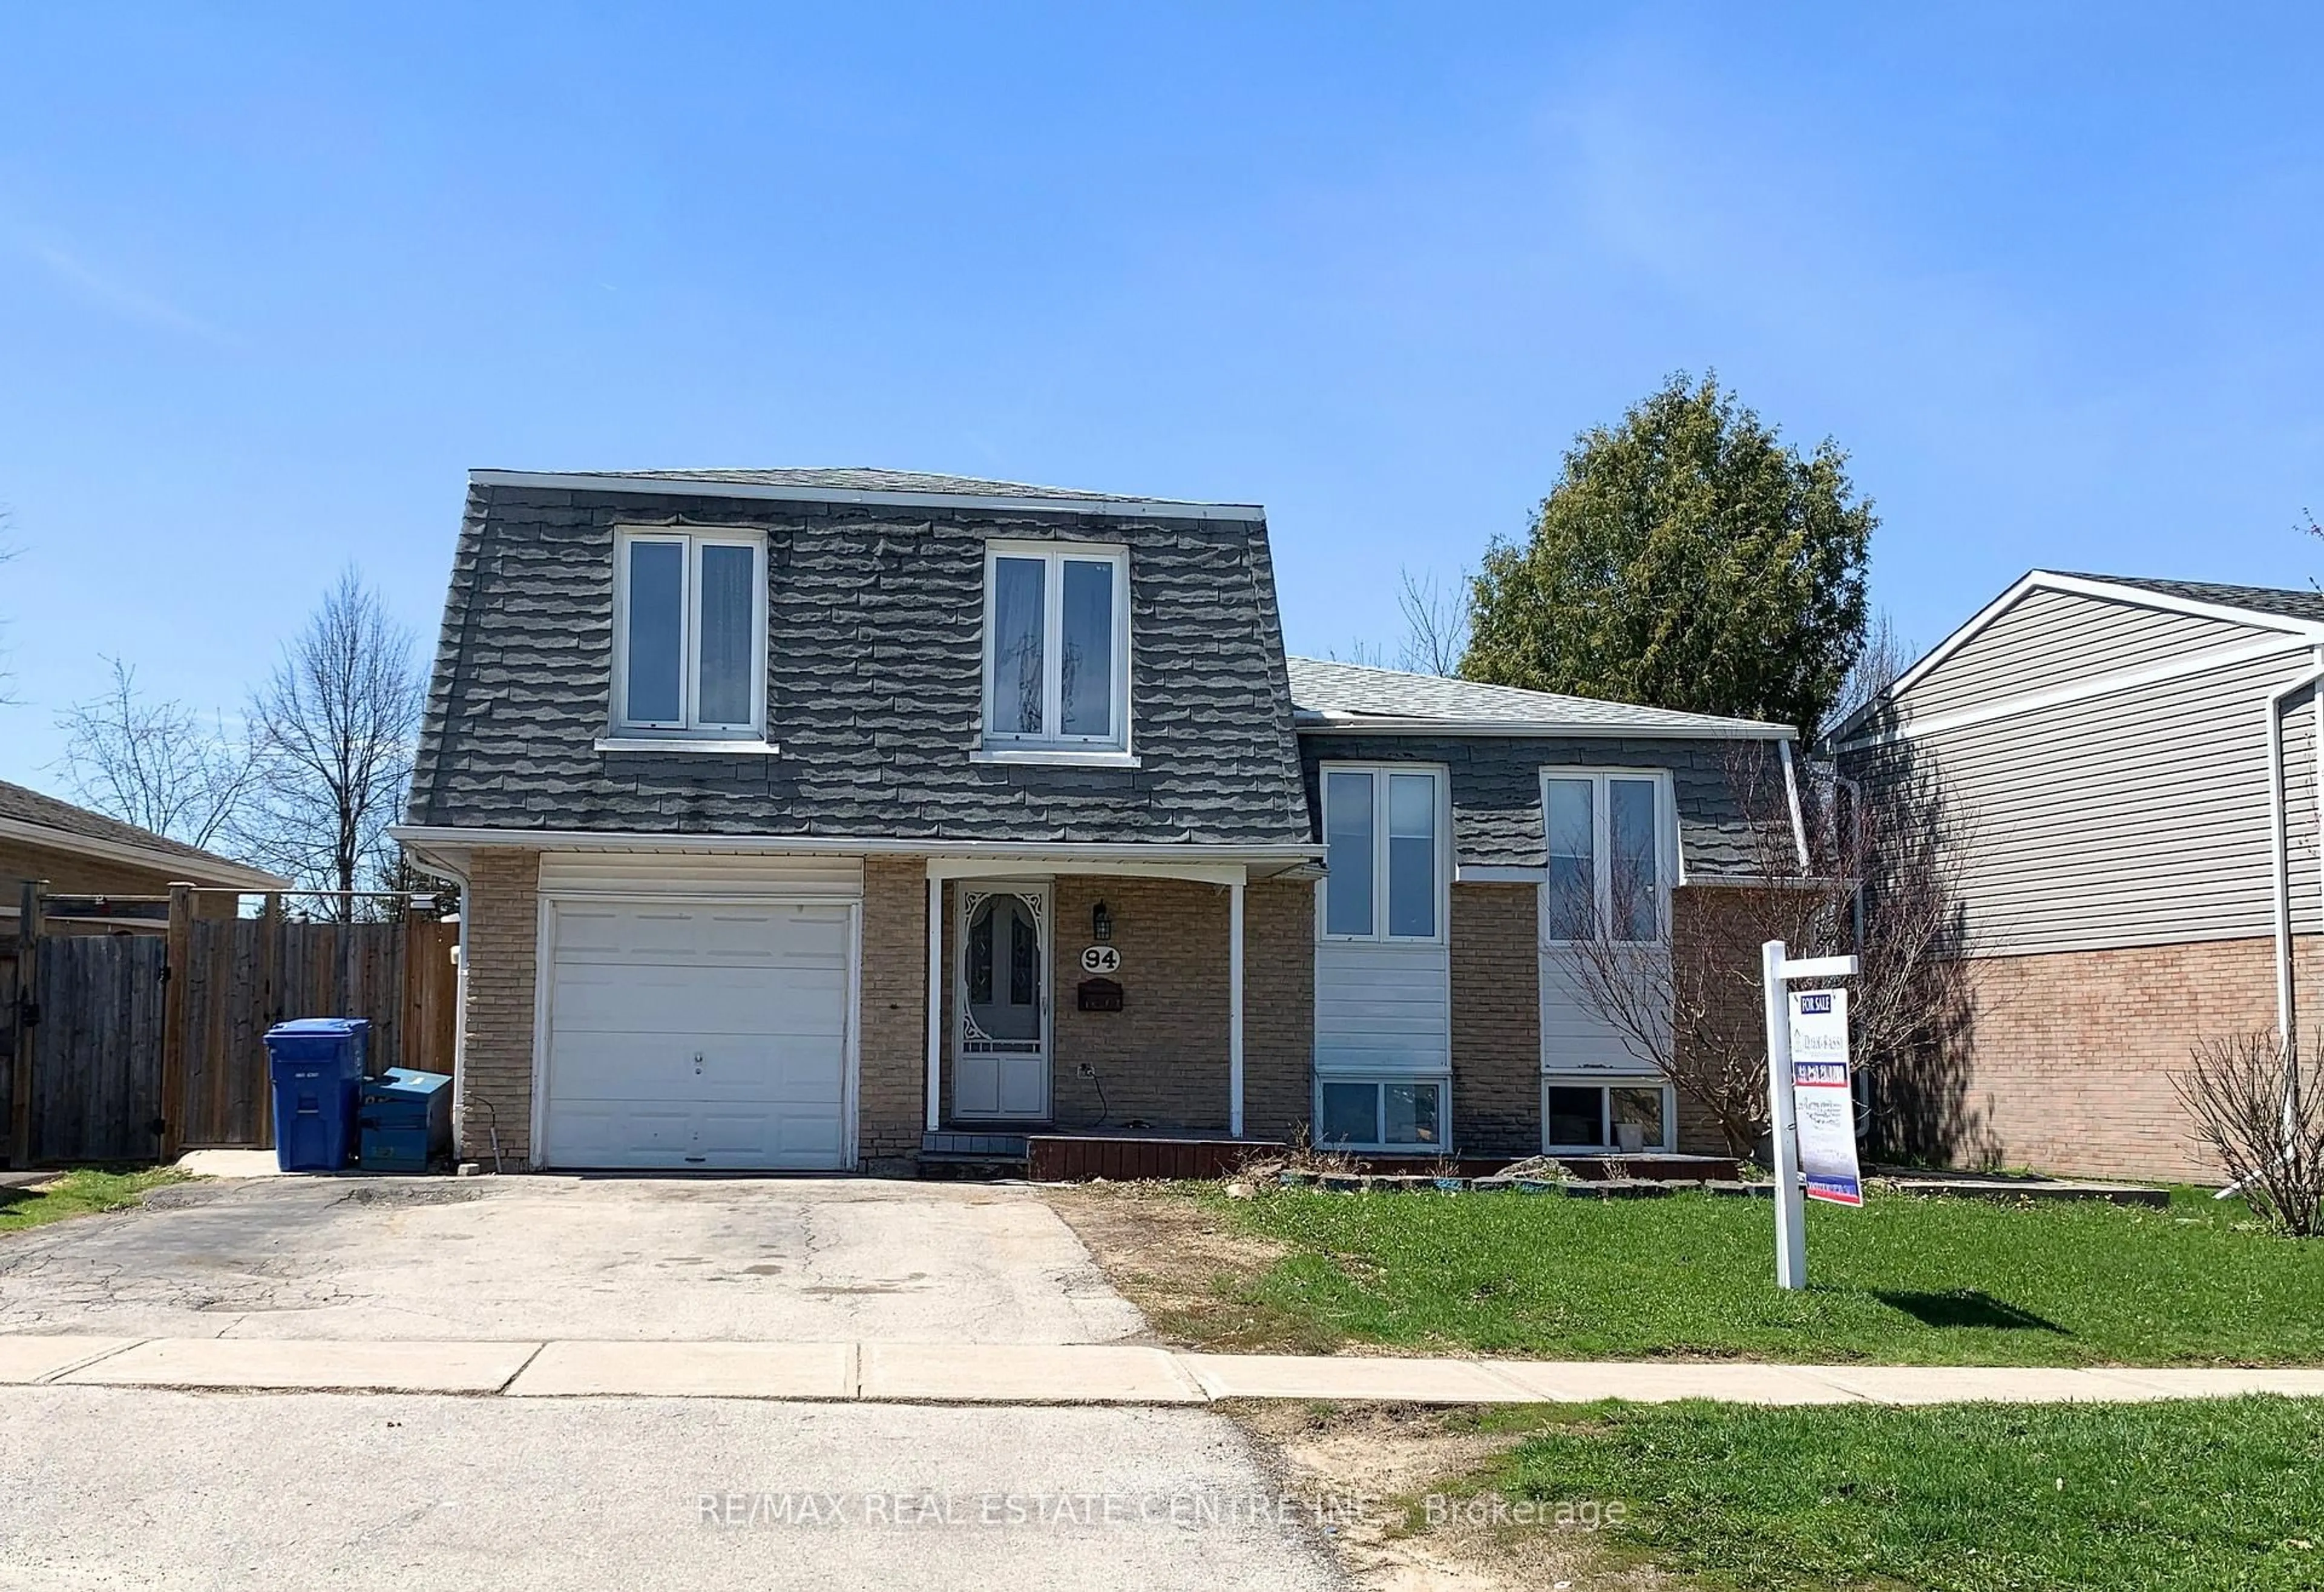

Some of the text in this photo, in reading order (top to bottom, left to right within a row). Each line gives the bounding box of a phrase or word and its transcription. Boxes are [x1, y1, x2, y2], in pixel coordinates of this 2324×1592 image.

[1085, 949, 1116, 969] 94
[1802, 996, 1830, 1011] FOR SALE
